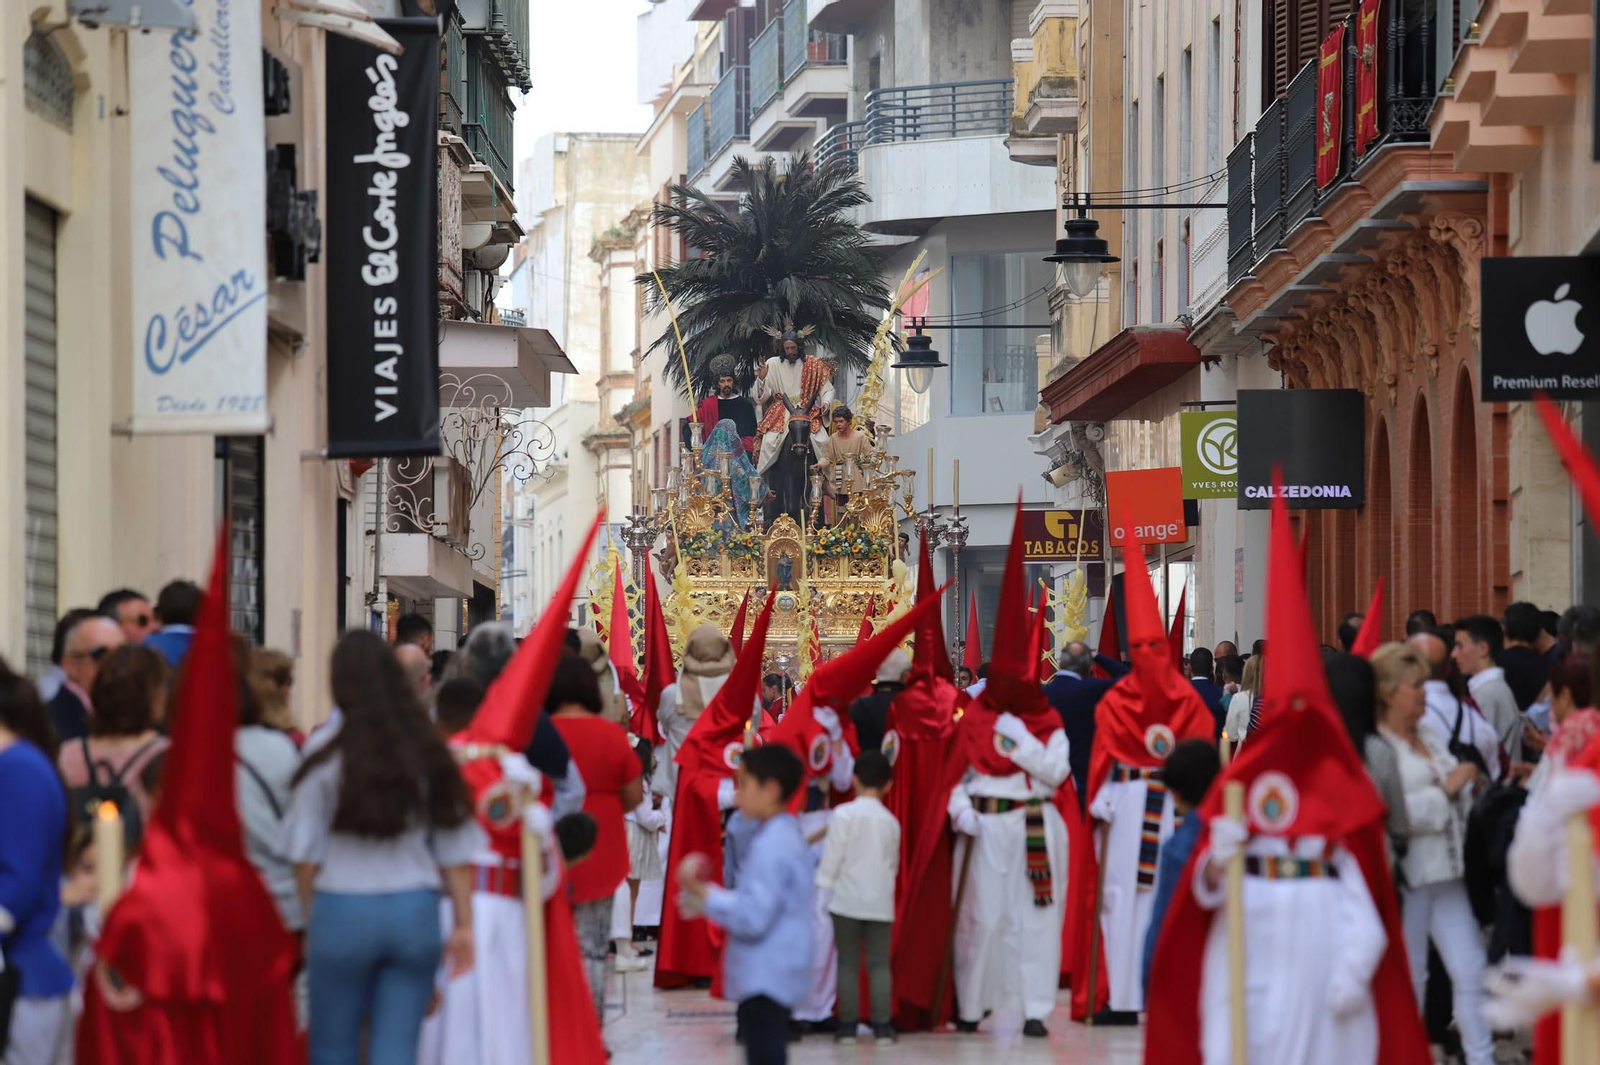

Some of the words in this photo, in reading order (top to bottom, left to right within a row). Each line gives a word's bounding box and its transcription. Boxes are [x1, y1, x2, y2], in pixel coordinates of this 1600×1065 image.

[353, 53, 411, 169] Inglés
[152, 0, 214, 261] Peluquer
[362, 170, 399, 250] Corte
[361, 250, 399, 286] El
[144, 268, 255, 375] César
[373, 296, 404, 422] VIAJES
[1492, 375, 1558, 389] Premium
[1192, 481, 1217, 489] YVES
[1244, 485, 1353, 498] CALZEDONIA
[1024, 540, 1099, 554] TABACOS
[1114, 523, 1178, 540] oange
